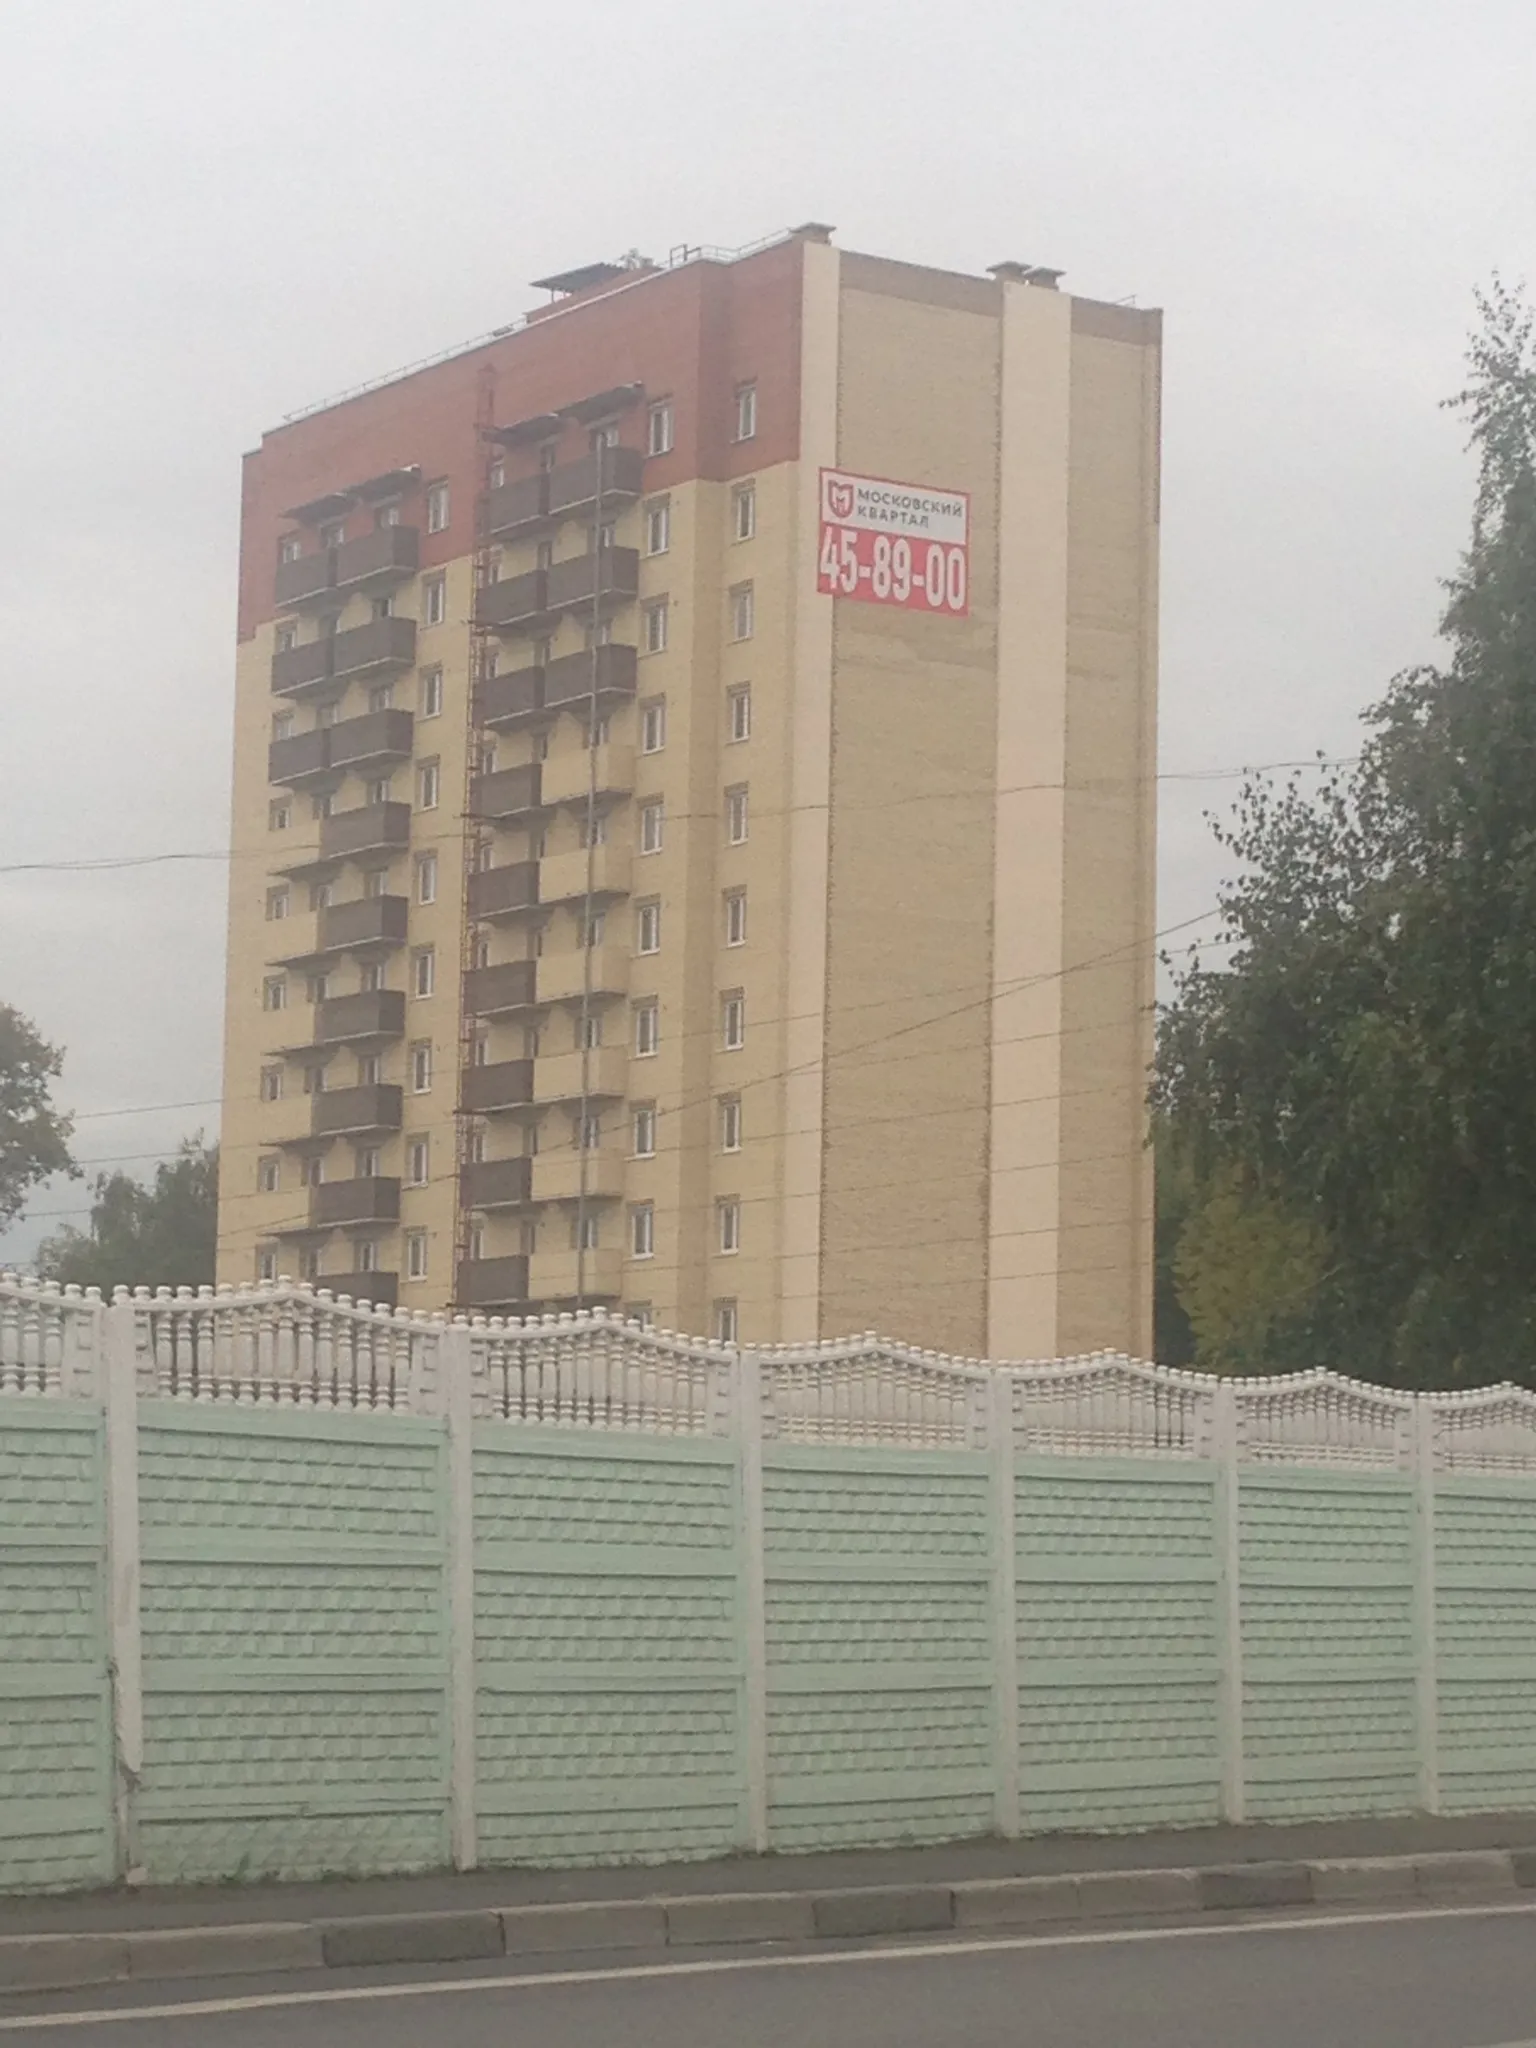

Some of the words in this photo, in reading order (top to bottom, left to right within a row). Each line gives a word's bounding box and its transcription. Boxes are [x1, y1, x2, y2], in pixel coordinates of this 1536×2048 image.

[857, 488, 963, 517] МОСКОВСКИЙ
[857, 505, 929, 528] КВАРТАЛ
[820, 526, 965, 610] 45-89-00
